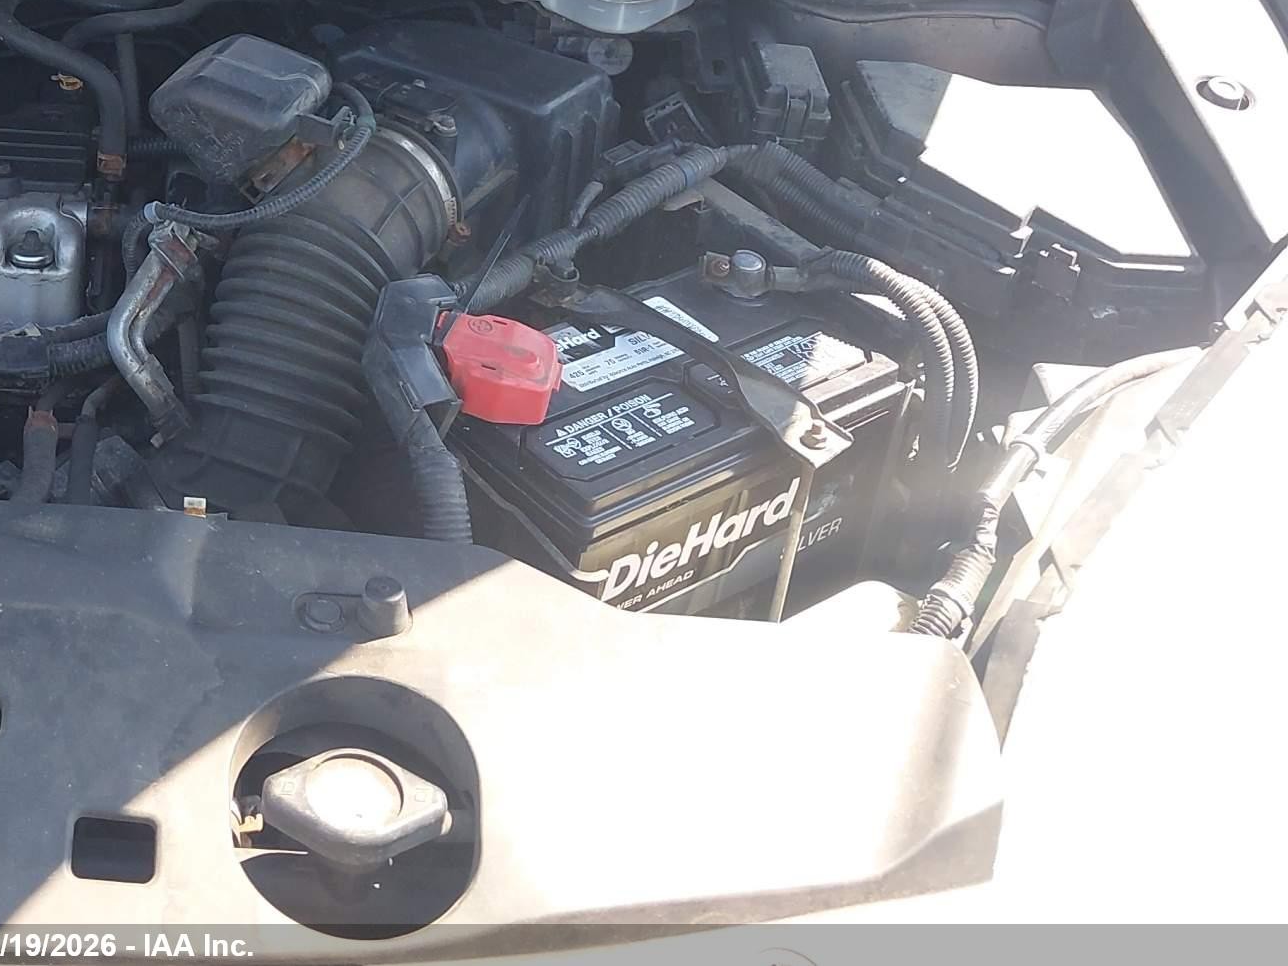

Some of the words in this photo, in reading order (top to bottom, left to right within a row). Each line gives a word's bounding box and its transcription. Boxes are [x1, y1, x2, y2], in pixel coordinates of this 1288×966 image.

[557, 328, 602, 352] eHard
[628, 333, 652, 345] SILV
[564, 413, 607, 433] DANGER
[613, 394, 652, 414] POISON
[601, 477, 800, 601] DieHard
[797, 517, 843, 553] LVER
[646, 570, 695, 598] AHEAD
